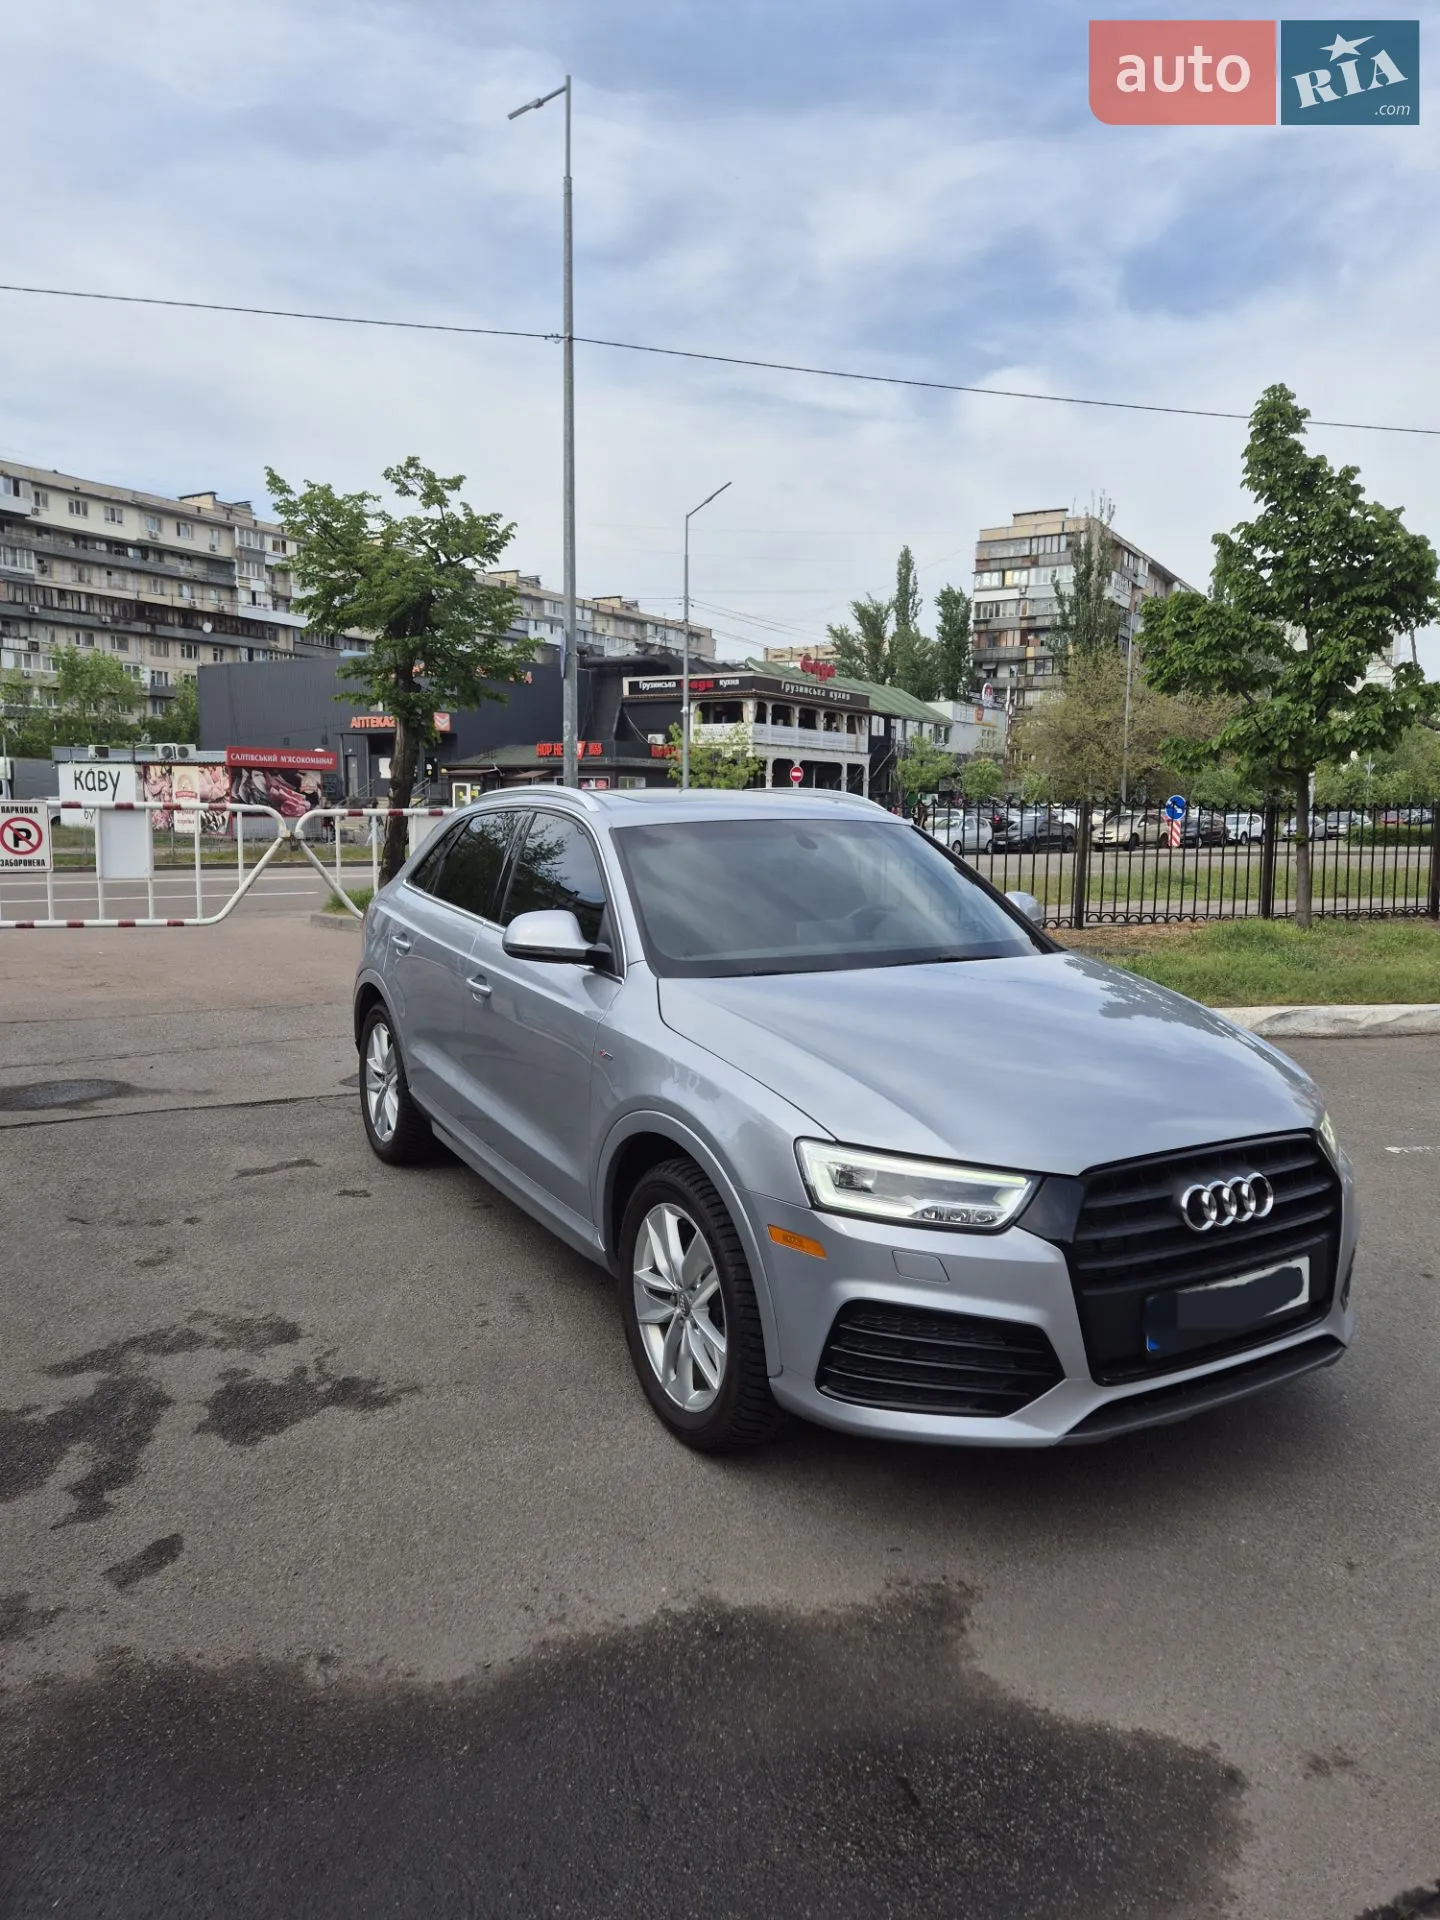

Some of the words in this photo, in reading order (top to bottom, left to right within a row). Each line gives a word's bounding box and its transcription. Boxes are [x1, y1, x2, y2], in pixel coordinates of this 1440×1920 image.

[639, 680, 676, 691] Грузинська
[781, 681, 826, 697] Грузинська
[230, 752, 278, 762] САЛТІВСЬКИЙ
[0, 805, 39, 814] ПАРКОВКА
[0, 858, 46, 867] ЗАБОРОНЕНА
